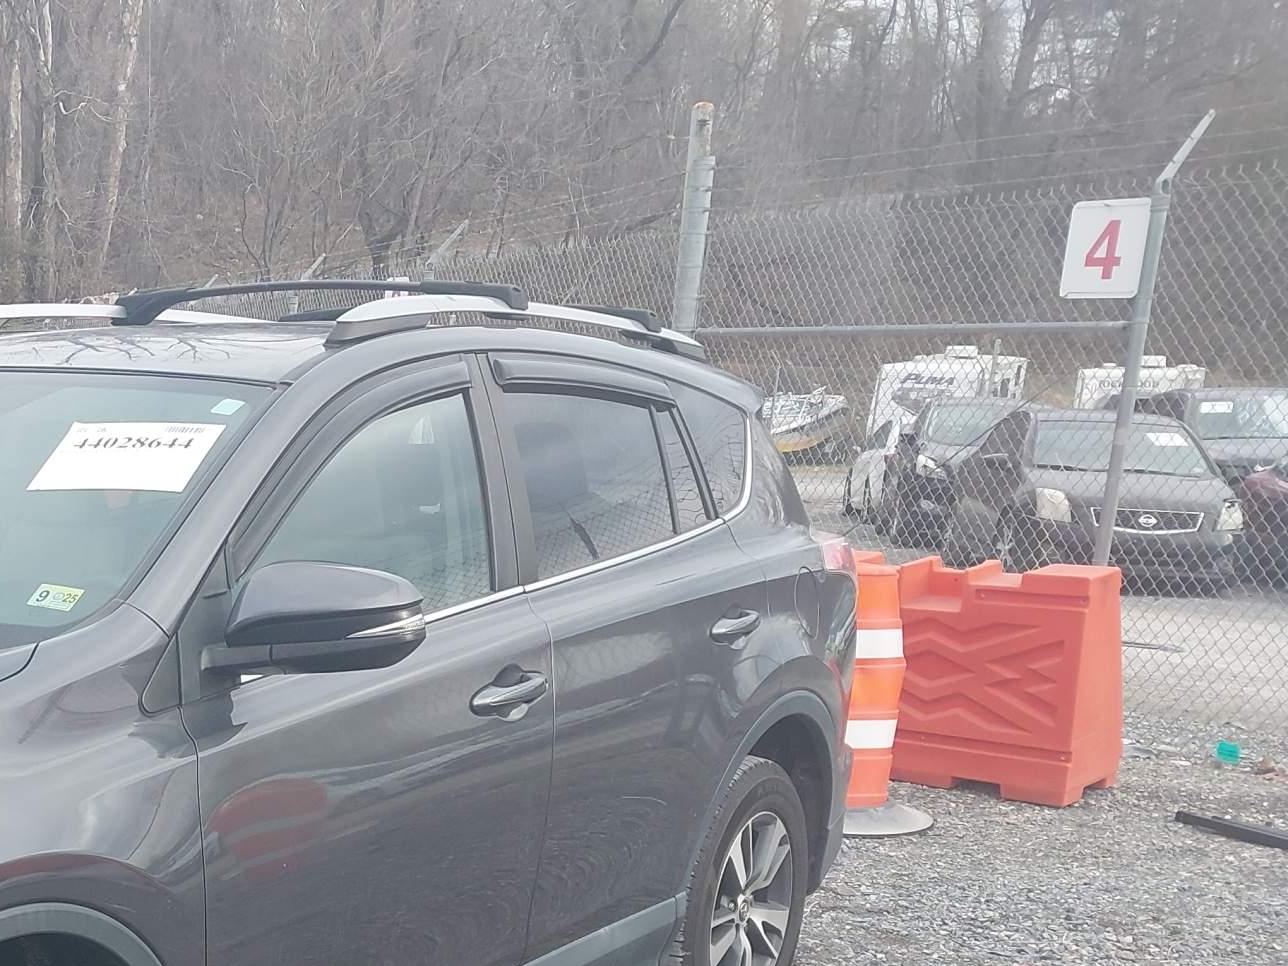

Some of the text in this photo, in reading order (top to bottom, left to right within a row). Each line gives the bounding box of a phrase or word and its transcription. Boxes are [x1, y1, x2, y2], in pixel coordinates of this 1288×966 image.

[1084, 219, 1122, 280] 4
[73, 436, 195, 449] 44028644
[35, 589, 79, 604] 9 25
